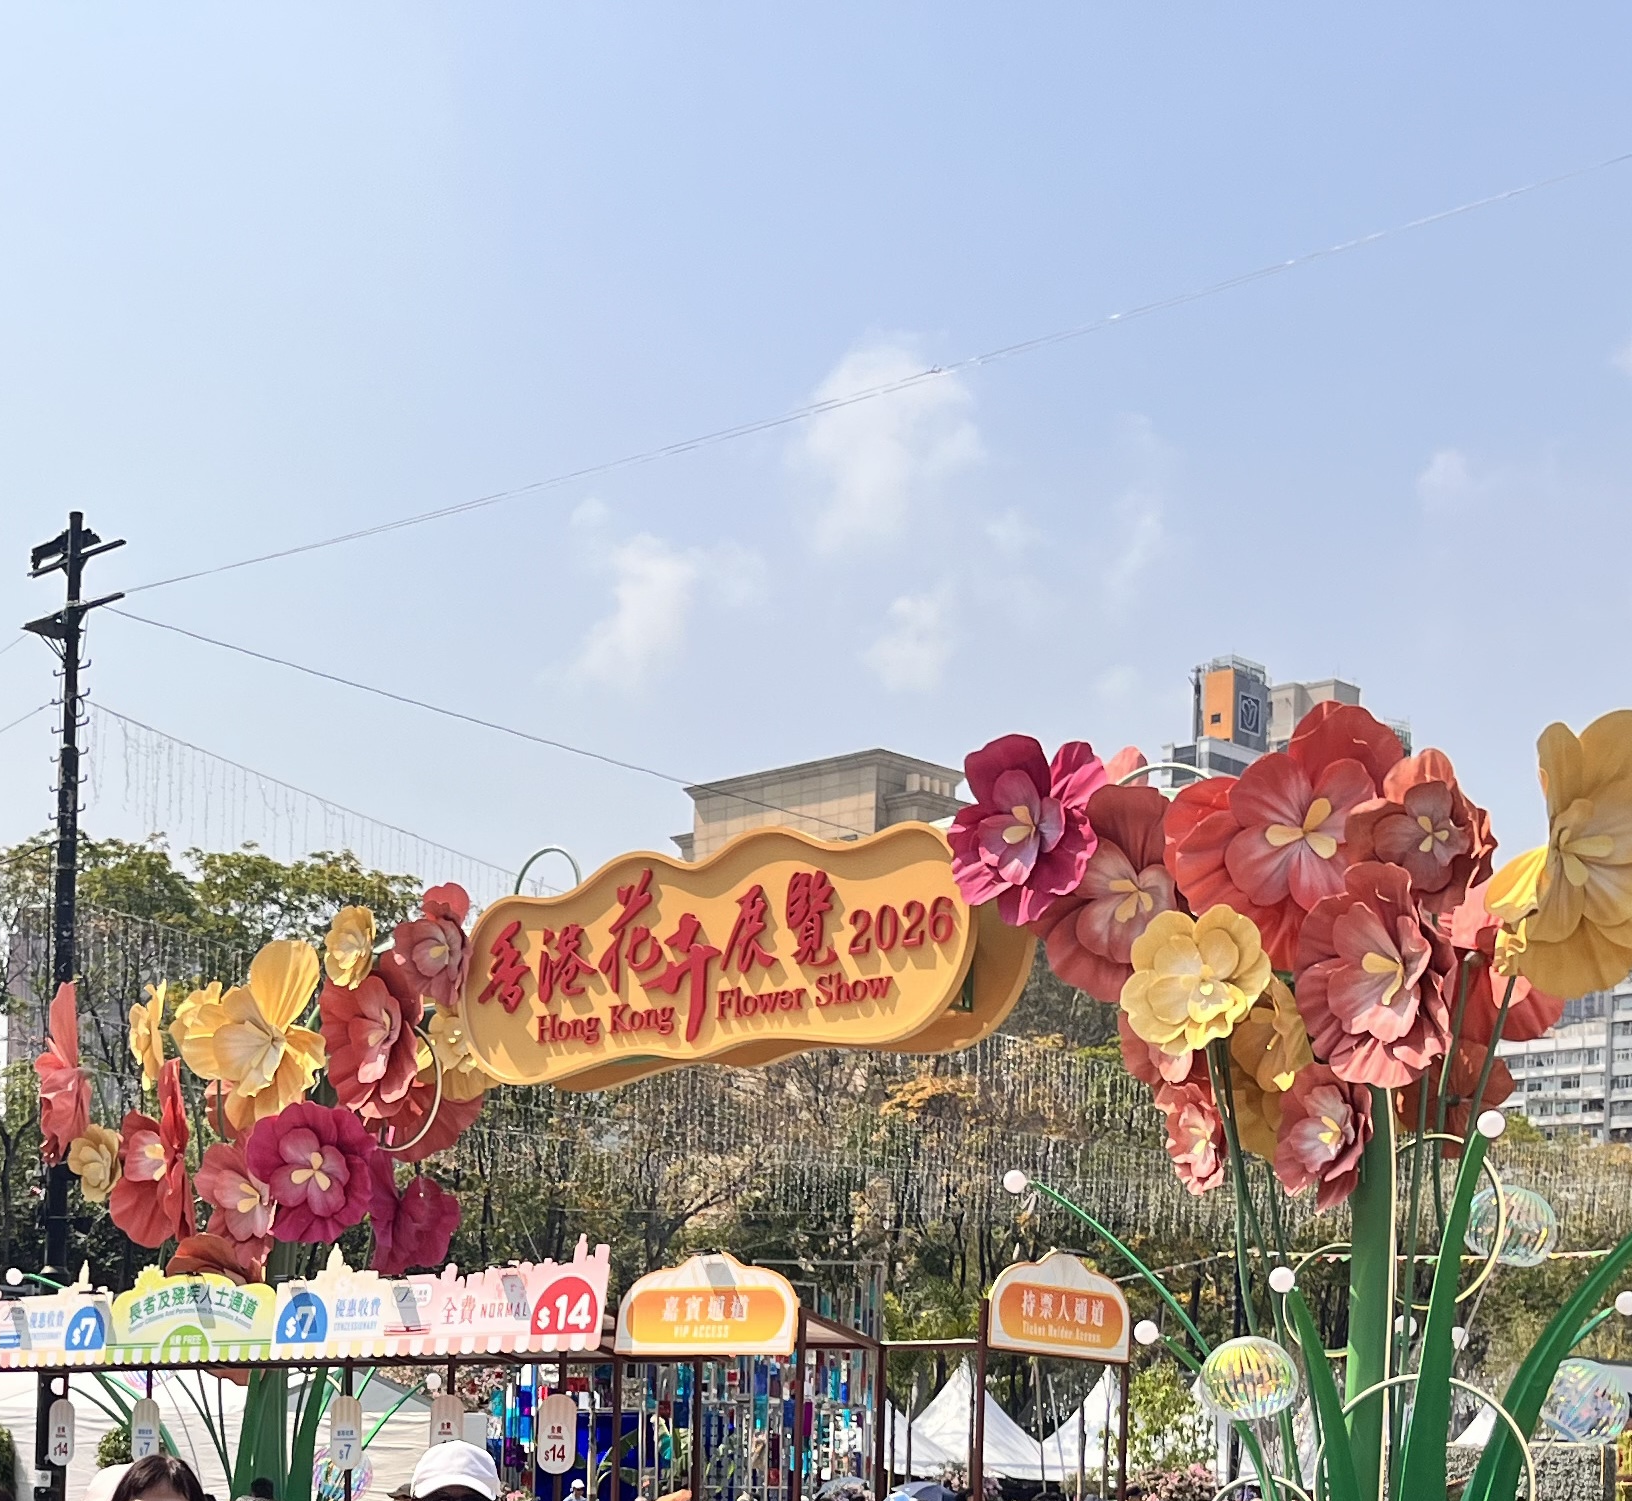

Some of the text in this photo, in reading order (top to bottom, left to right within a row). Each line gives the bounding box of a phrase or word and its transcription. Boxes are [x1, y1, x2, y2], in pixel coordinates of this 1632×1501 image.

[479, 868, 955, 1043] 香港花卉展覽 2026
[536, 970, 894, 1046] Hong Kong Flower Show
[129, 1283, 259, 1324] 長者及殘疾人士通道
[335, 1296, 382, 1319] 優惠收費
[440, 1295, 476, 1325] 全費
[480, 1302, 528, 1319] NORMAL
[536, 1293, 592, 1331] $14
[661, 1294, 750, 1322] 嘉賓通道
[1021, 1289, 1105, 1328] 持票人通道
[29, 1310, 65, 1329] 優惠收費
[71, 1317, 97, 1347] $7
[285, 1306, 316, 1339] $7
[673, 1324, 730, 1338] VIP ACCESS
[53, 1441, 69, 1457] $14
[139, 1441, 151, 1457] $7
[338, 1443, 352, 1460] $7
[544, 1444, 566, 1462] $14
